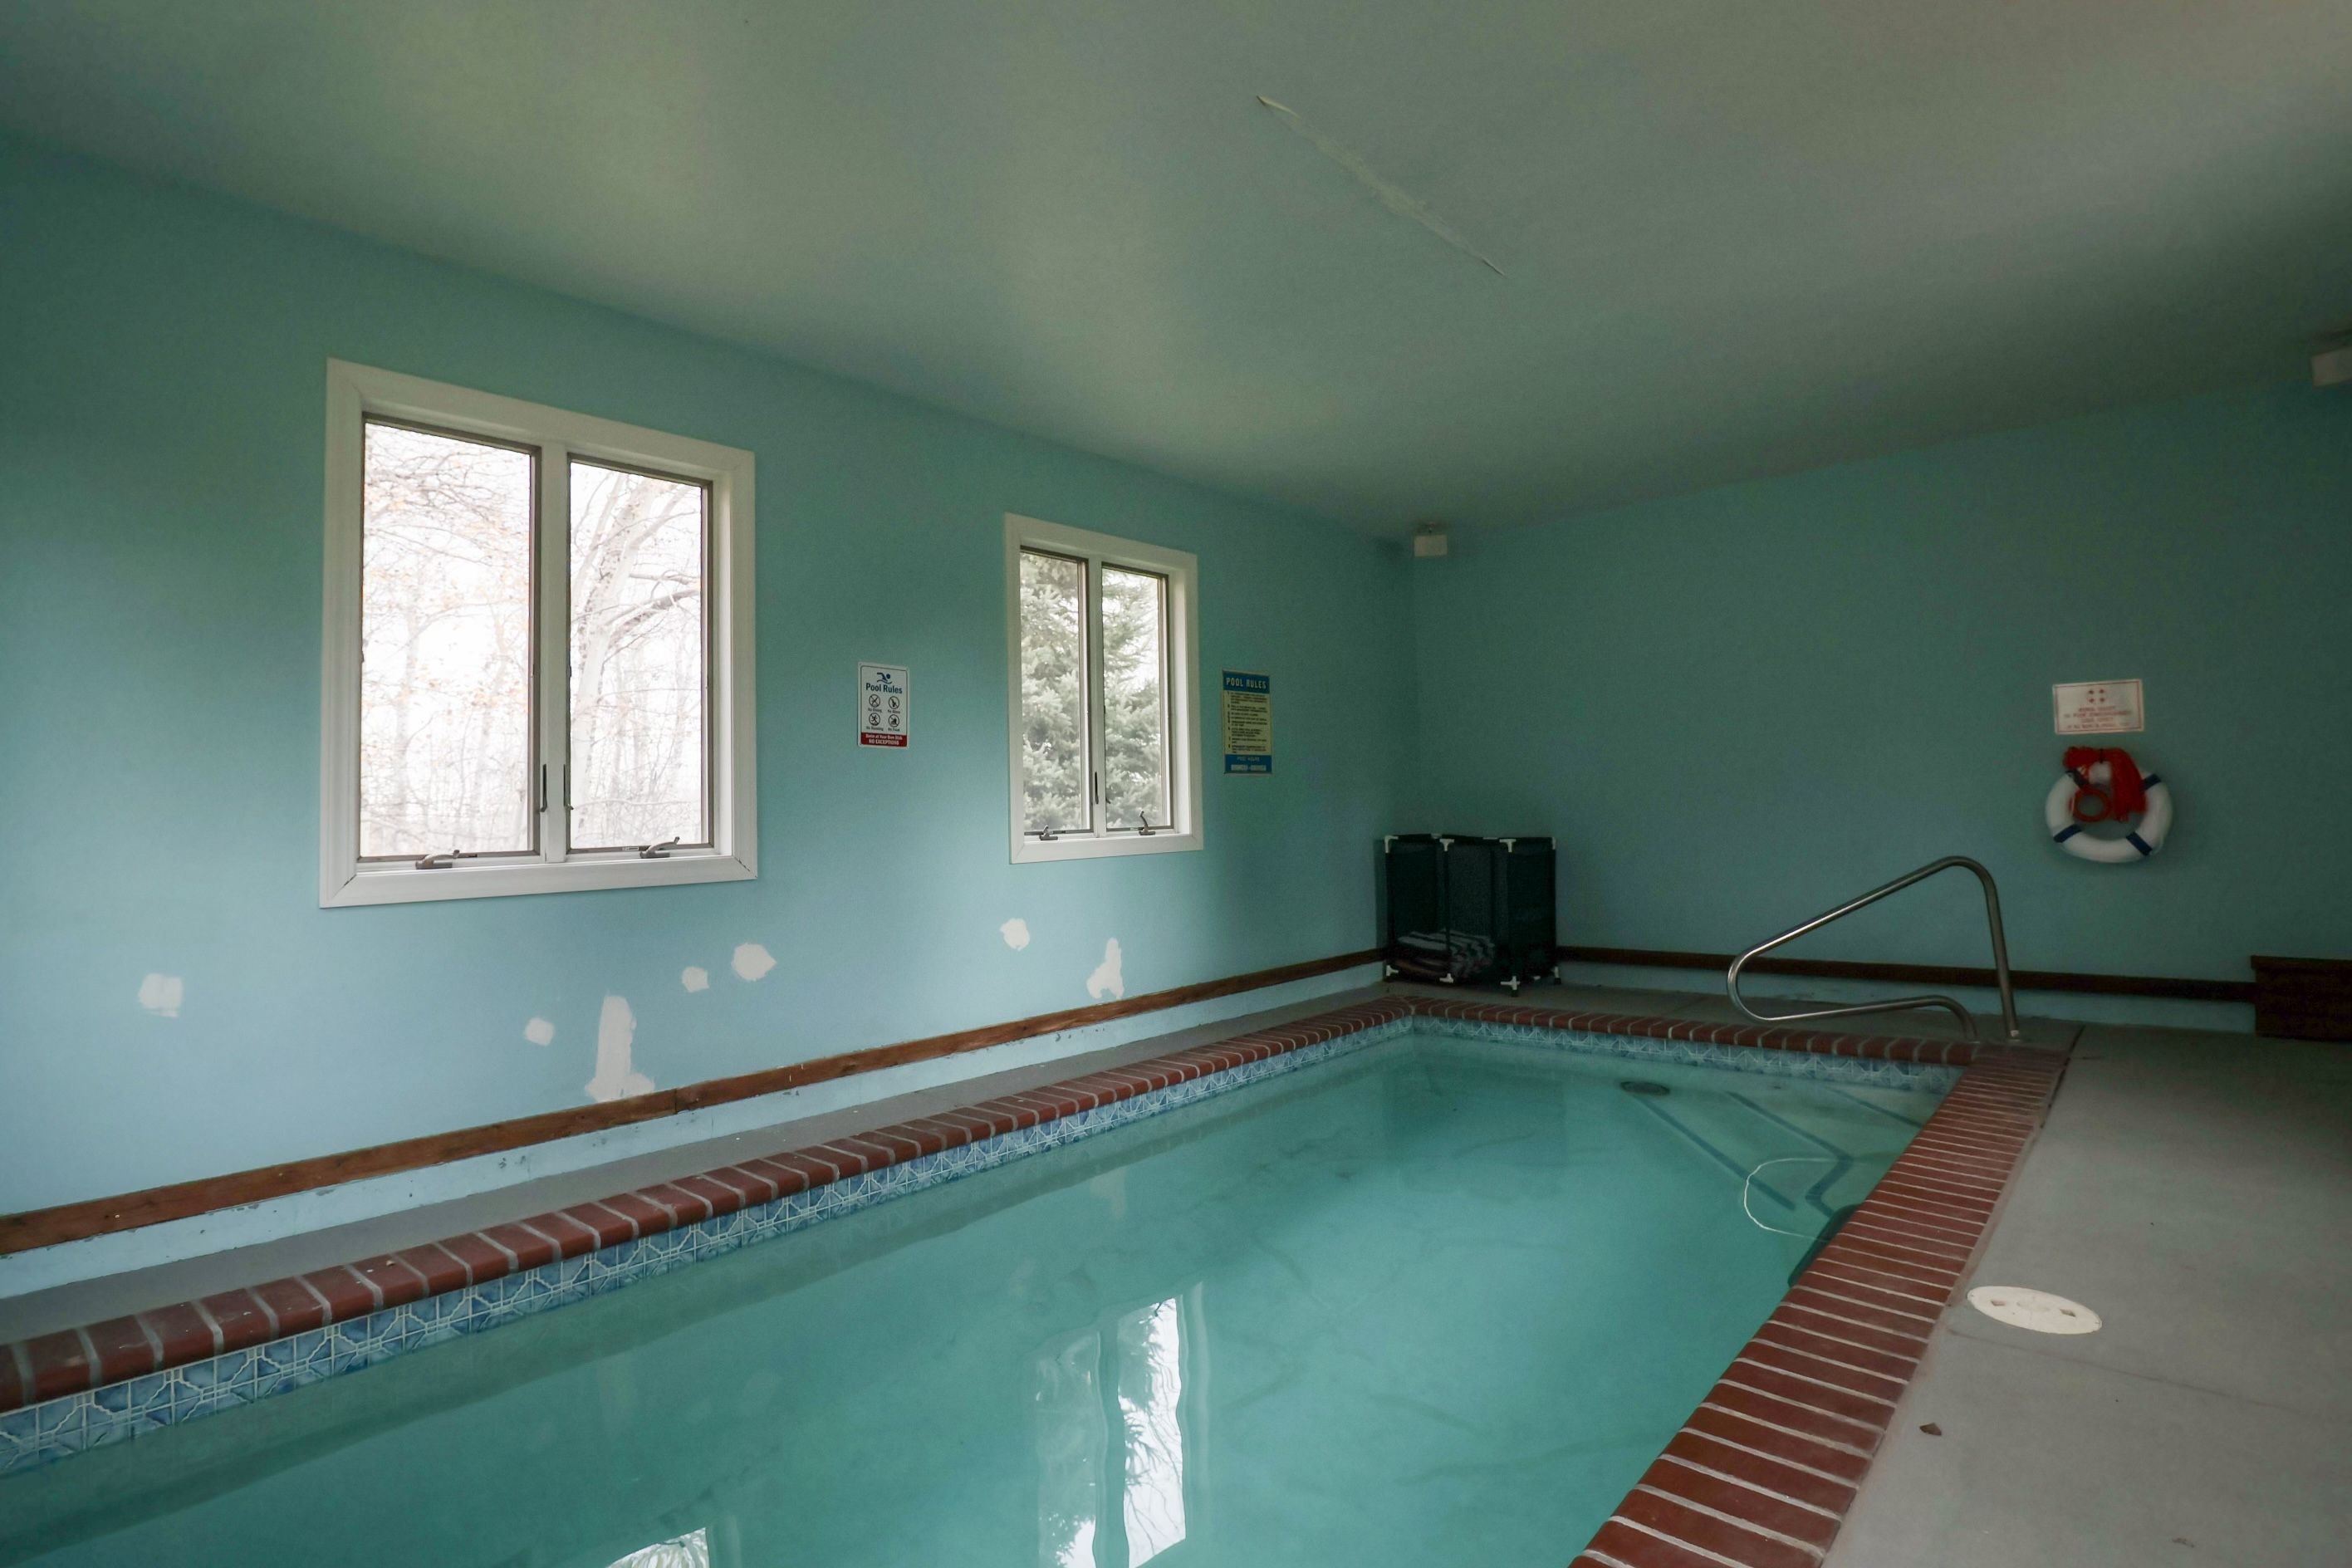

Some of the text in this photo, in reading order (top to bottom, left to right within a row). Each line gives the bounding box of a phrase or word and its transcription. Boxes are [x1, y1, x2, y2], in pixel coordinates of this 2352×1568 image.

[865, 683, 902, 693] Pool Rules
[1226, 677, 1267, 689] POOL RULES
